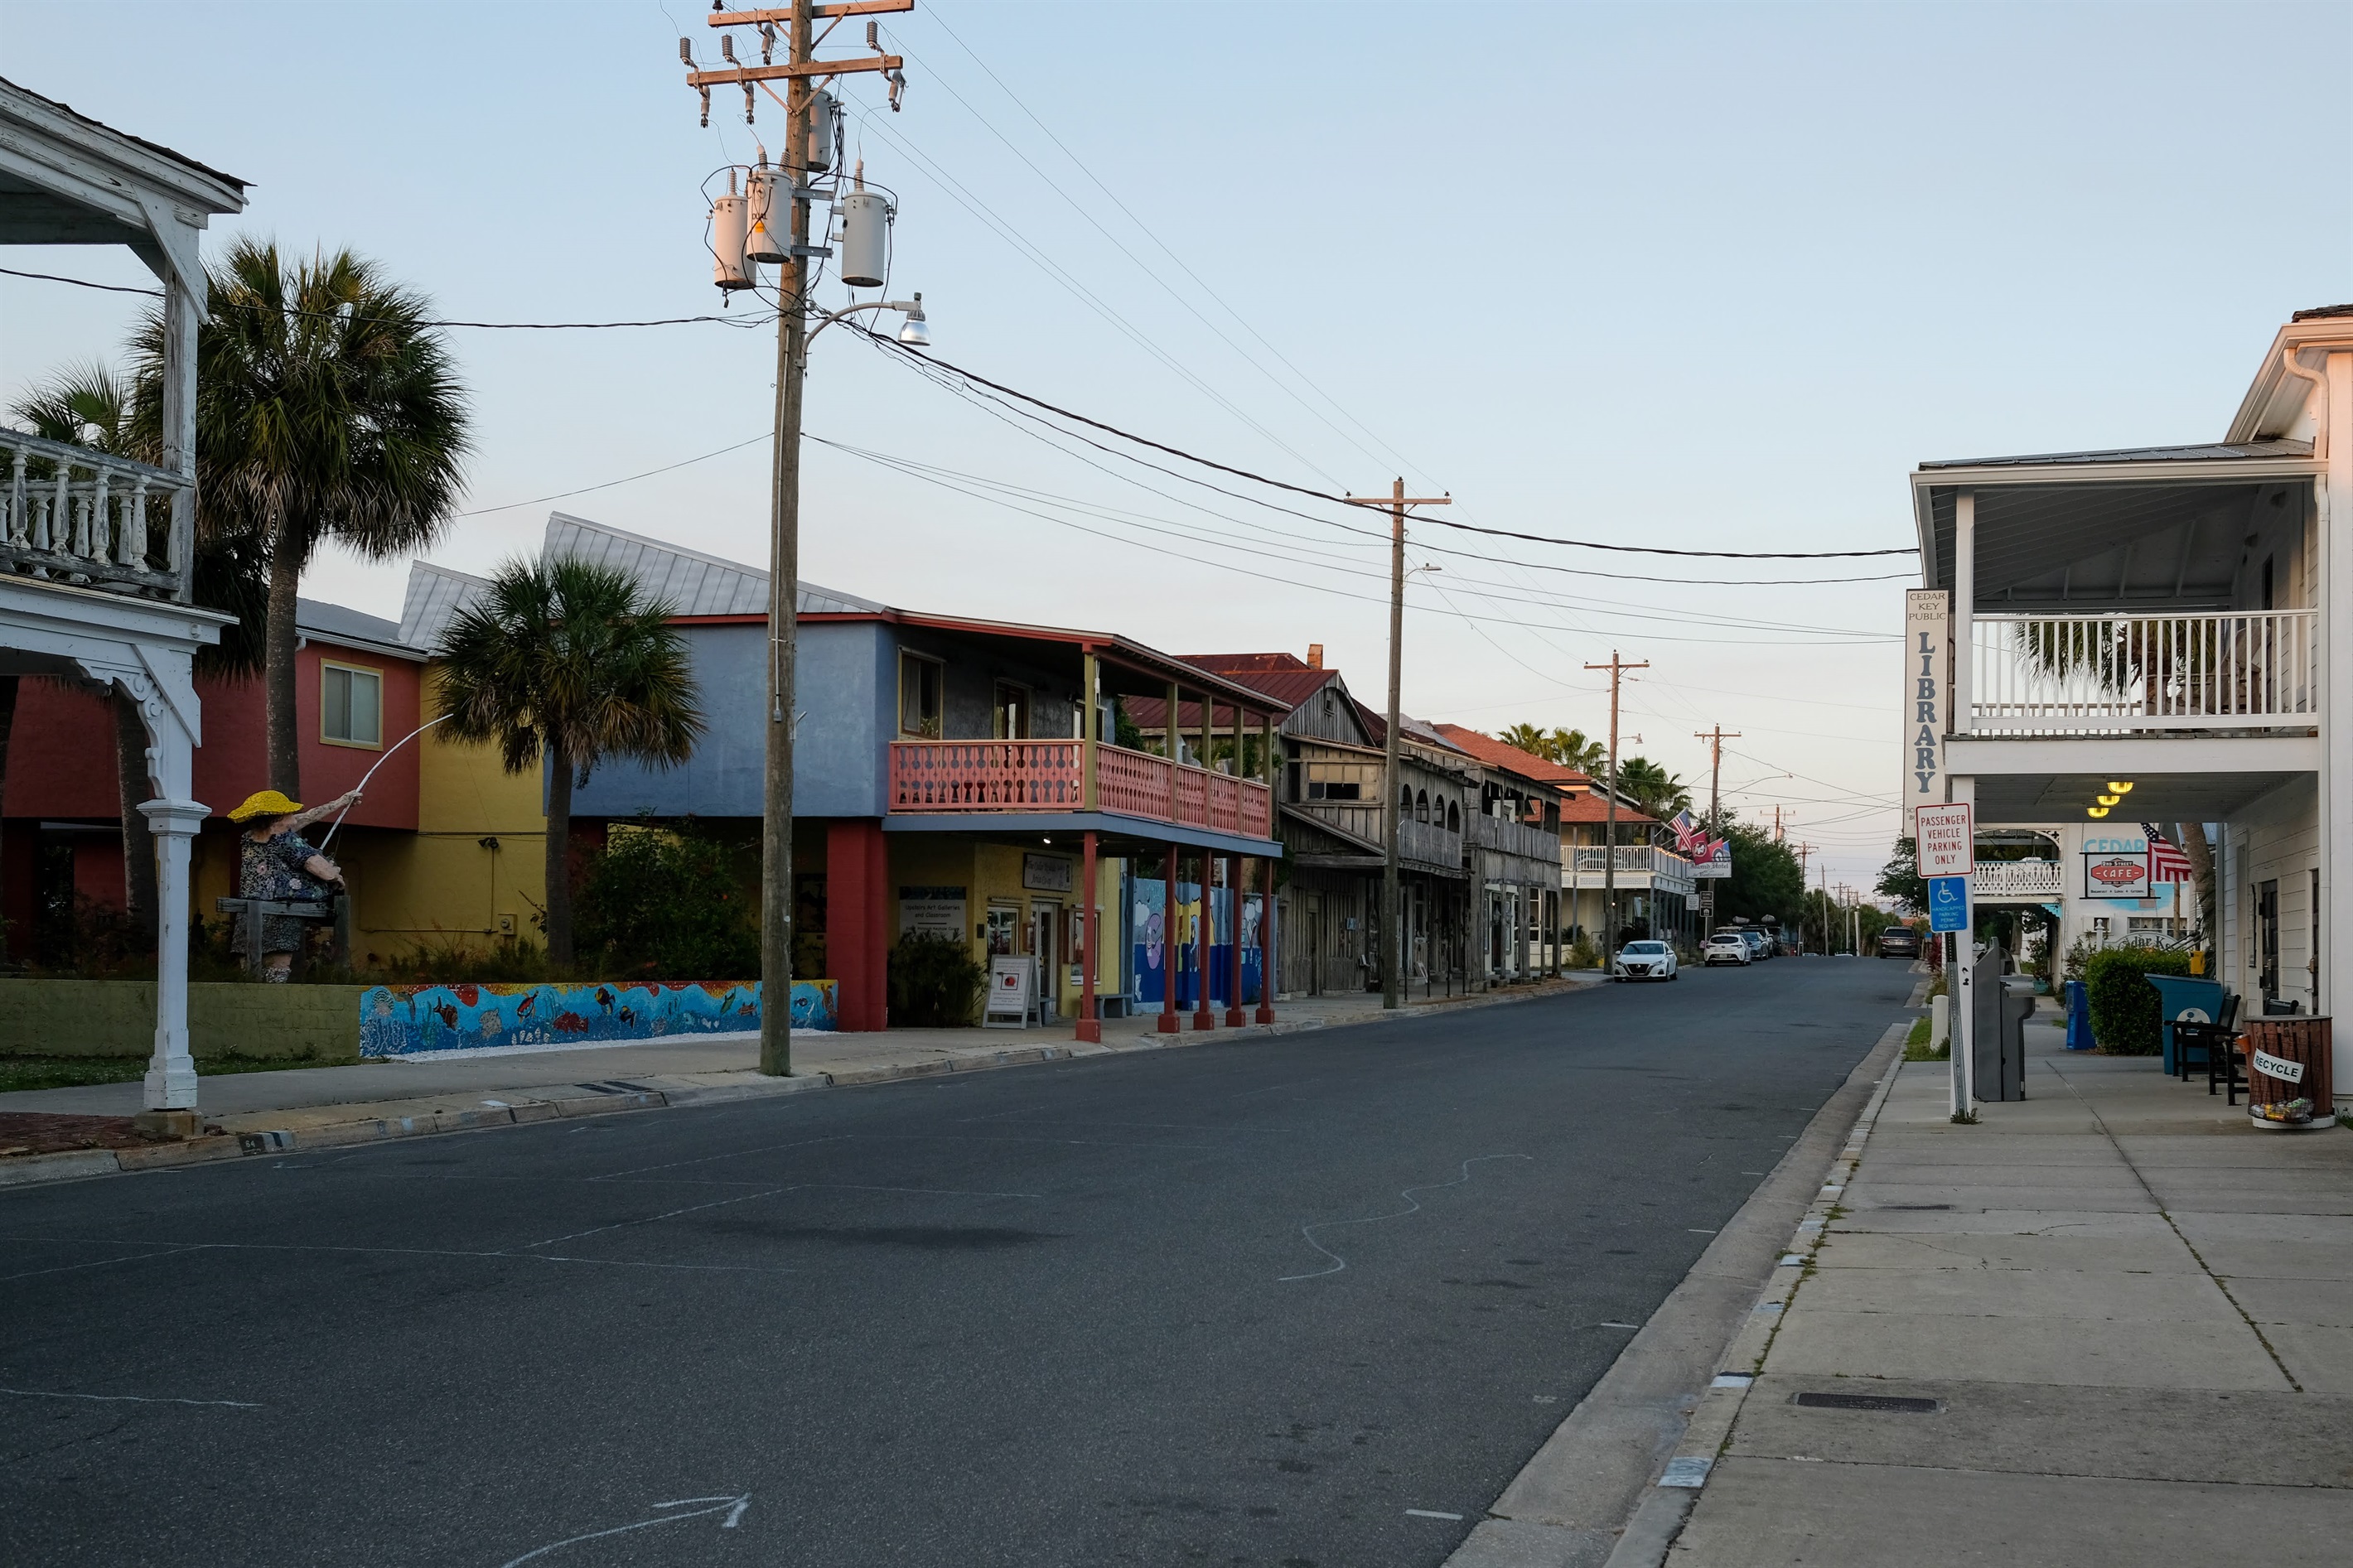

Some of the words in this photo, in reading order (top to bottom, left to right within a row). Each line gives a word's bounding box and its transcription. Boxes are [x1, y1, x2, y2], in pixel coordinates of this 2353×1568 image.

[1910, 592, 1945, 601] CEDAR
[1918, 602, 1940, 610] KEY
[1908, 612, 1946, 621] PUBLIC
[1914, 632, 1937, 793] LIBRARY
[1921, 814, 1966, 827] PASSENGER
[1927, 827, 1960, 839] VEHICLE
[1927, 841, 1962, 852] PARKING
[1935, 854, 1956, 865] ONLY
[2103, 869, 2133, 877] CAFE
[2254, 1055, 2299, 1078] RECYCLE
